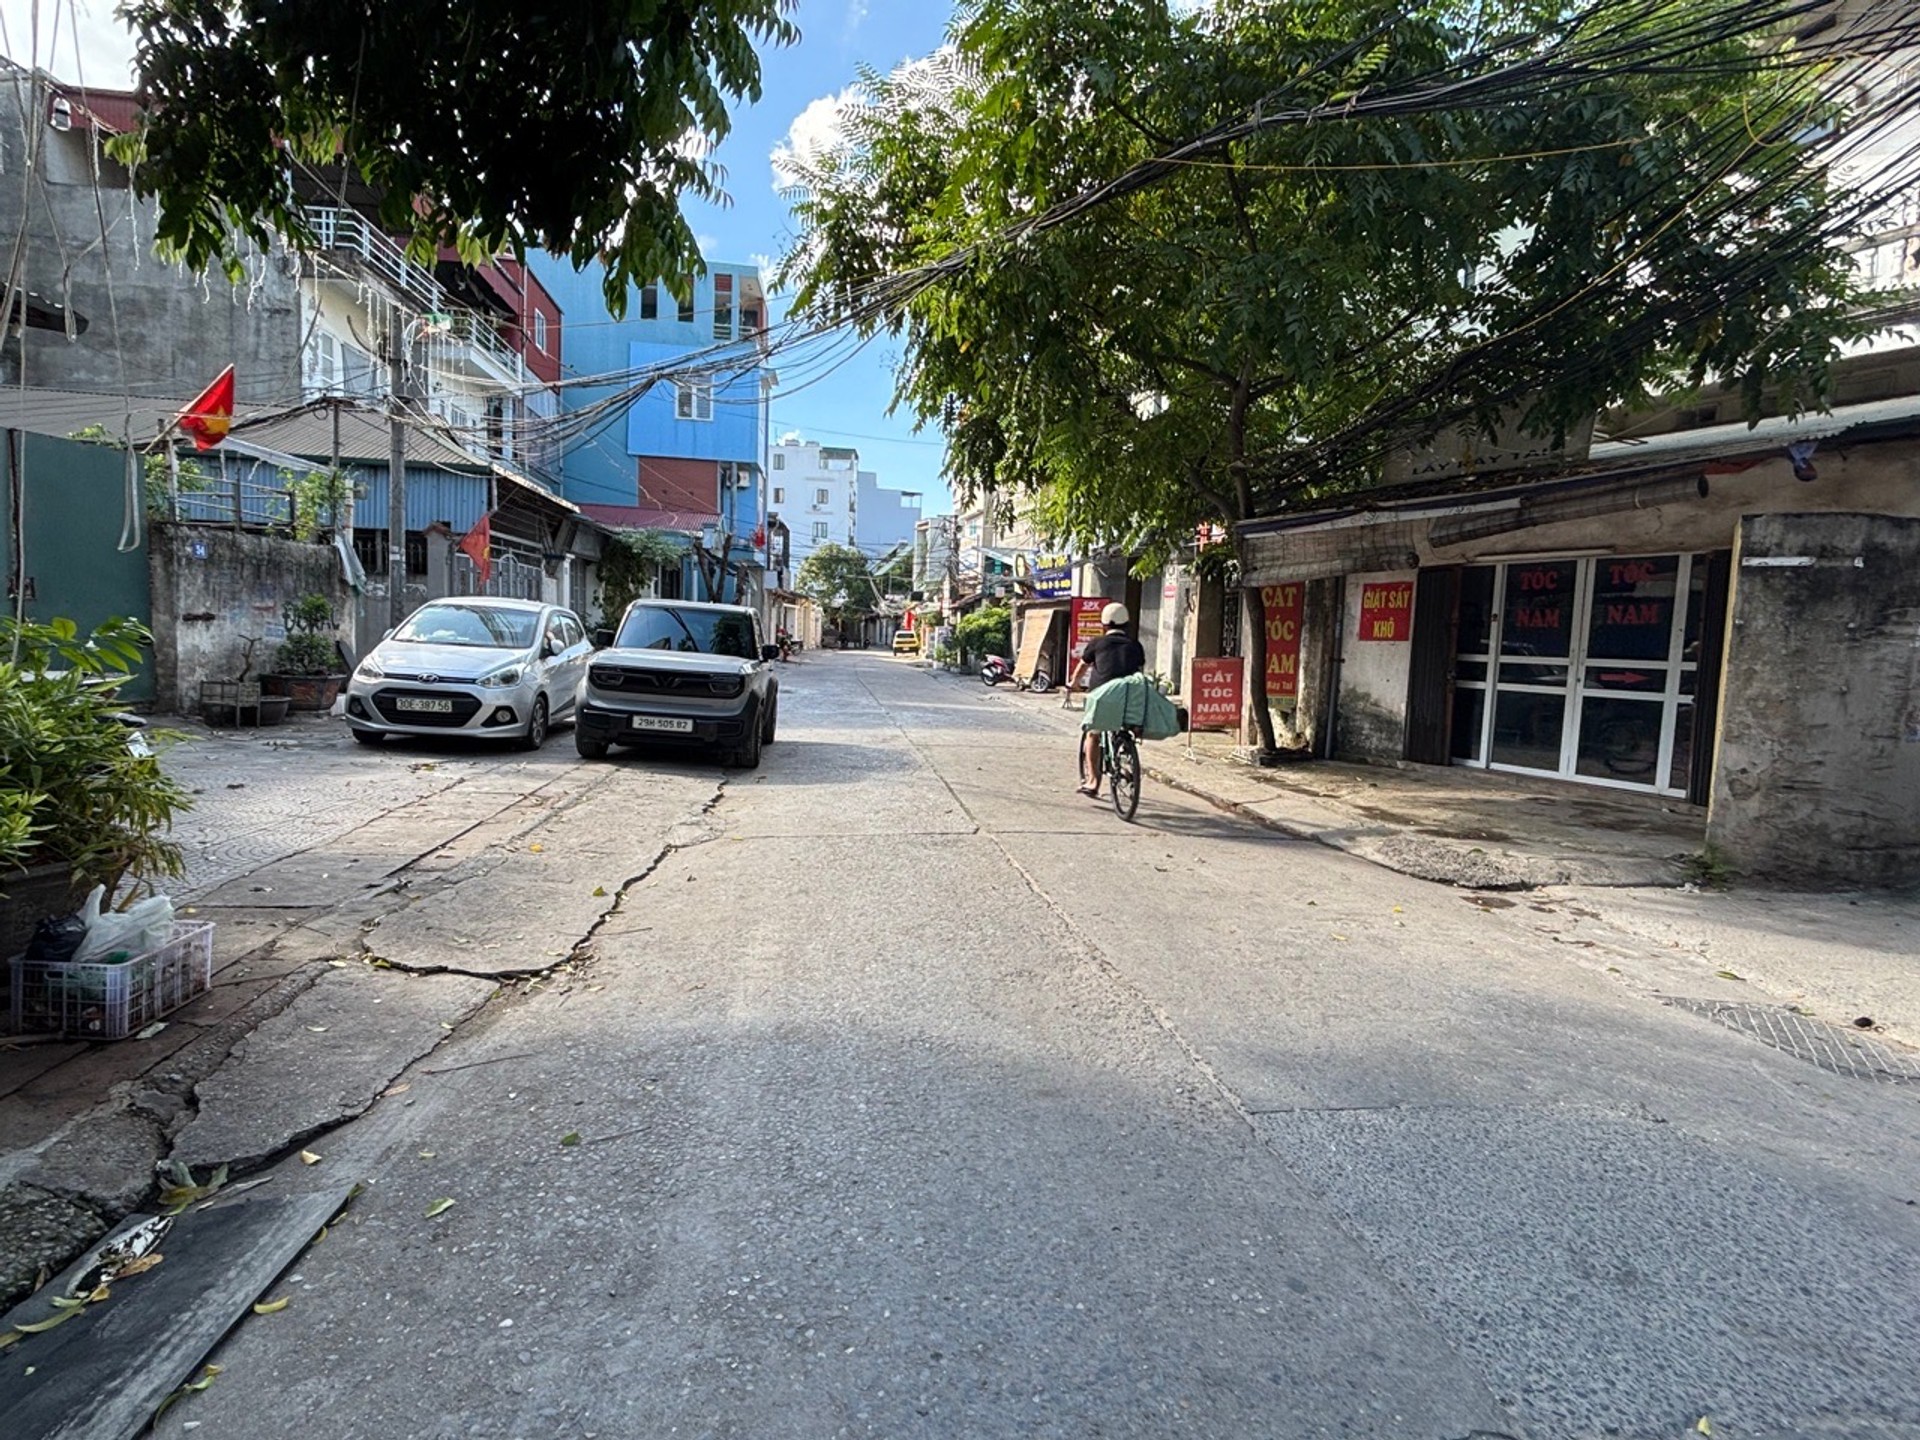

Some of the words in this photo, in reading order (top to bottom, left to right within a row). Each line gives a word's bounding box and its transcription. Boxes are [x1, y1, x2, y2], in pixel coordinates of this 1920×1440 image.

[1519, 566, 1558, 591] TÓC
[1515, 607, 1560, 629] NAM
[1606, 603, 1659, 625] NAM
[1267, 653, 1296, 674] AM
[1201, 686, 1233, 698] TÓC
[1197, 703, 1236, 713] NAM
